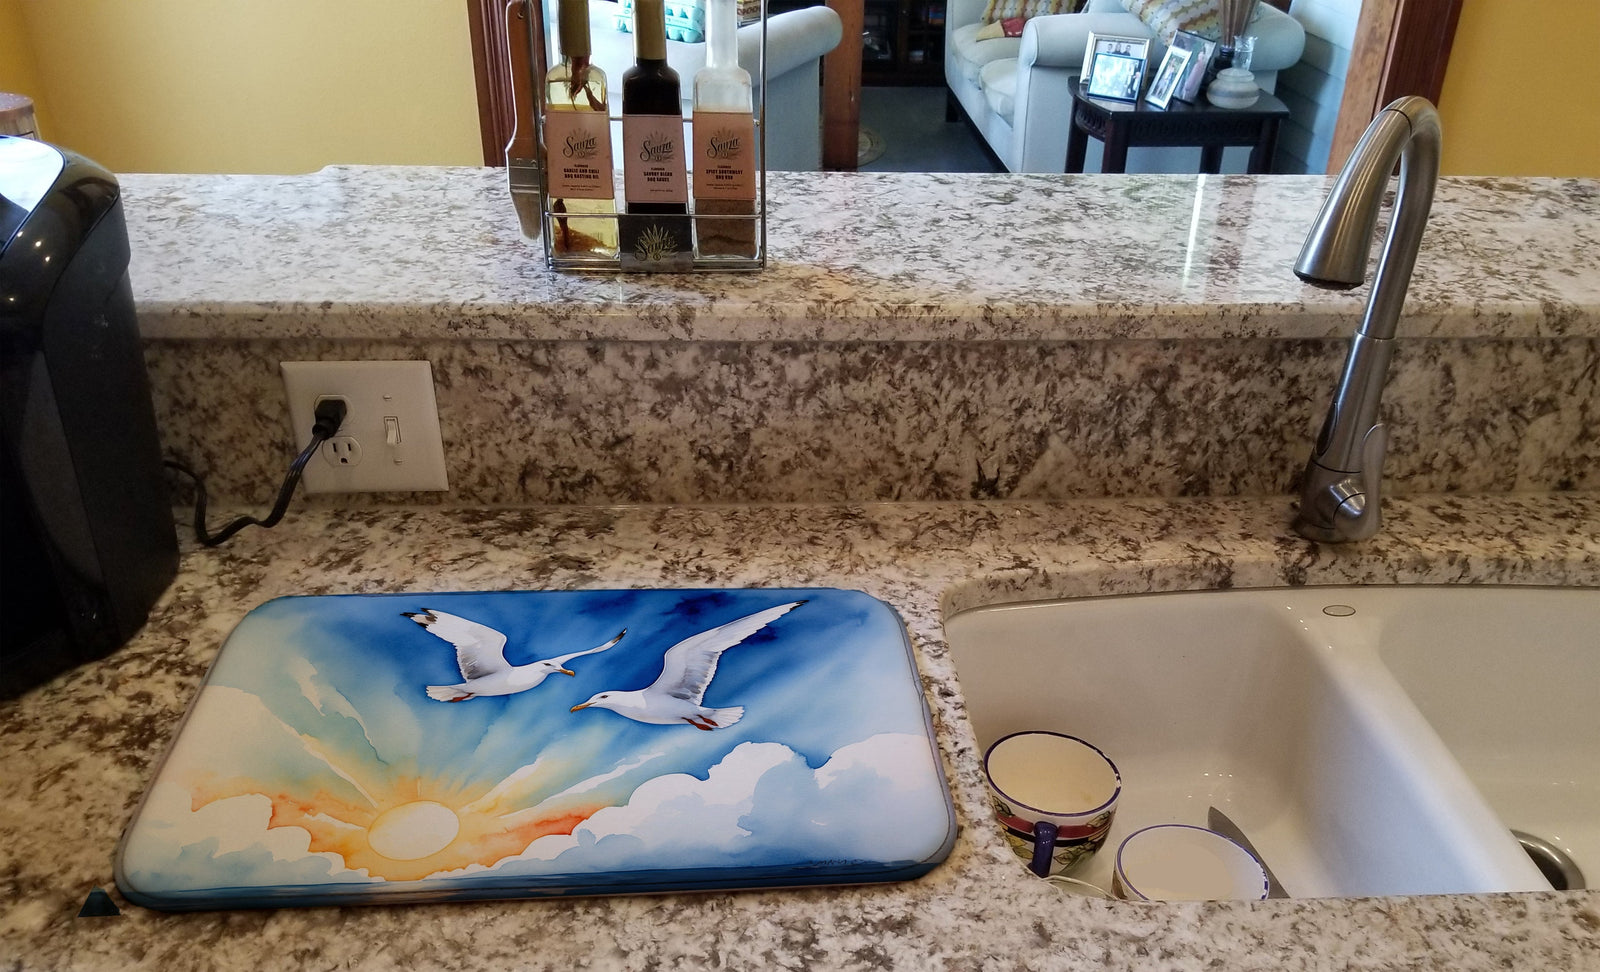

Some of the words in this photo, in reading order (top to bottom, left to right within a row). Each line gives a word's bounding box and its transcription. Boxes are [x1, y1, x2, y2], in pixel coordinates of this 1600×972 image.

[563, 136, 597, 158] Sauza
[640, 140, 673, 162] Sauza
[707, 137, 740, 159] Sauza
